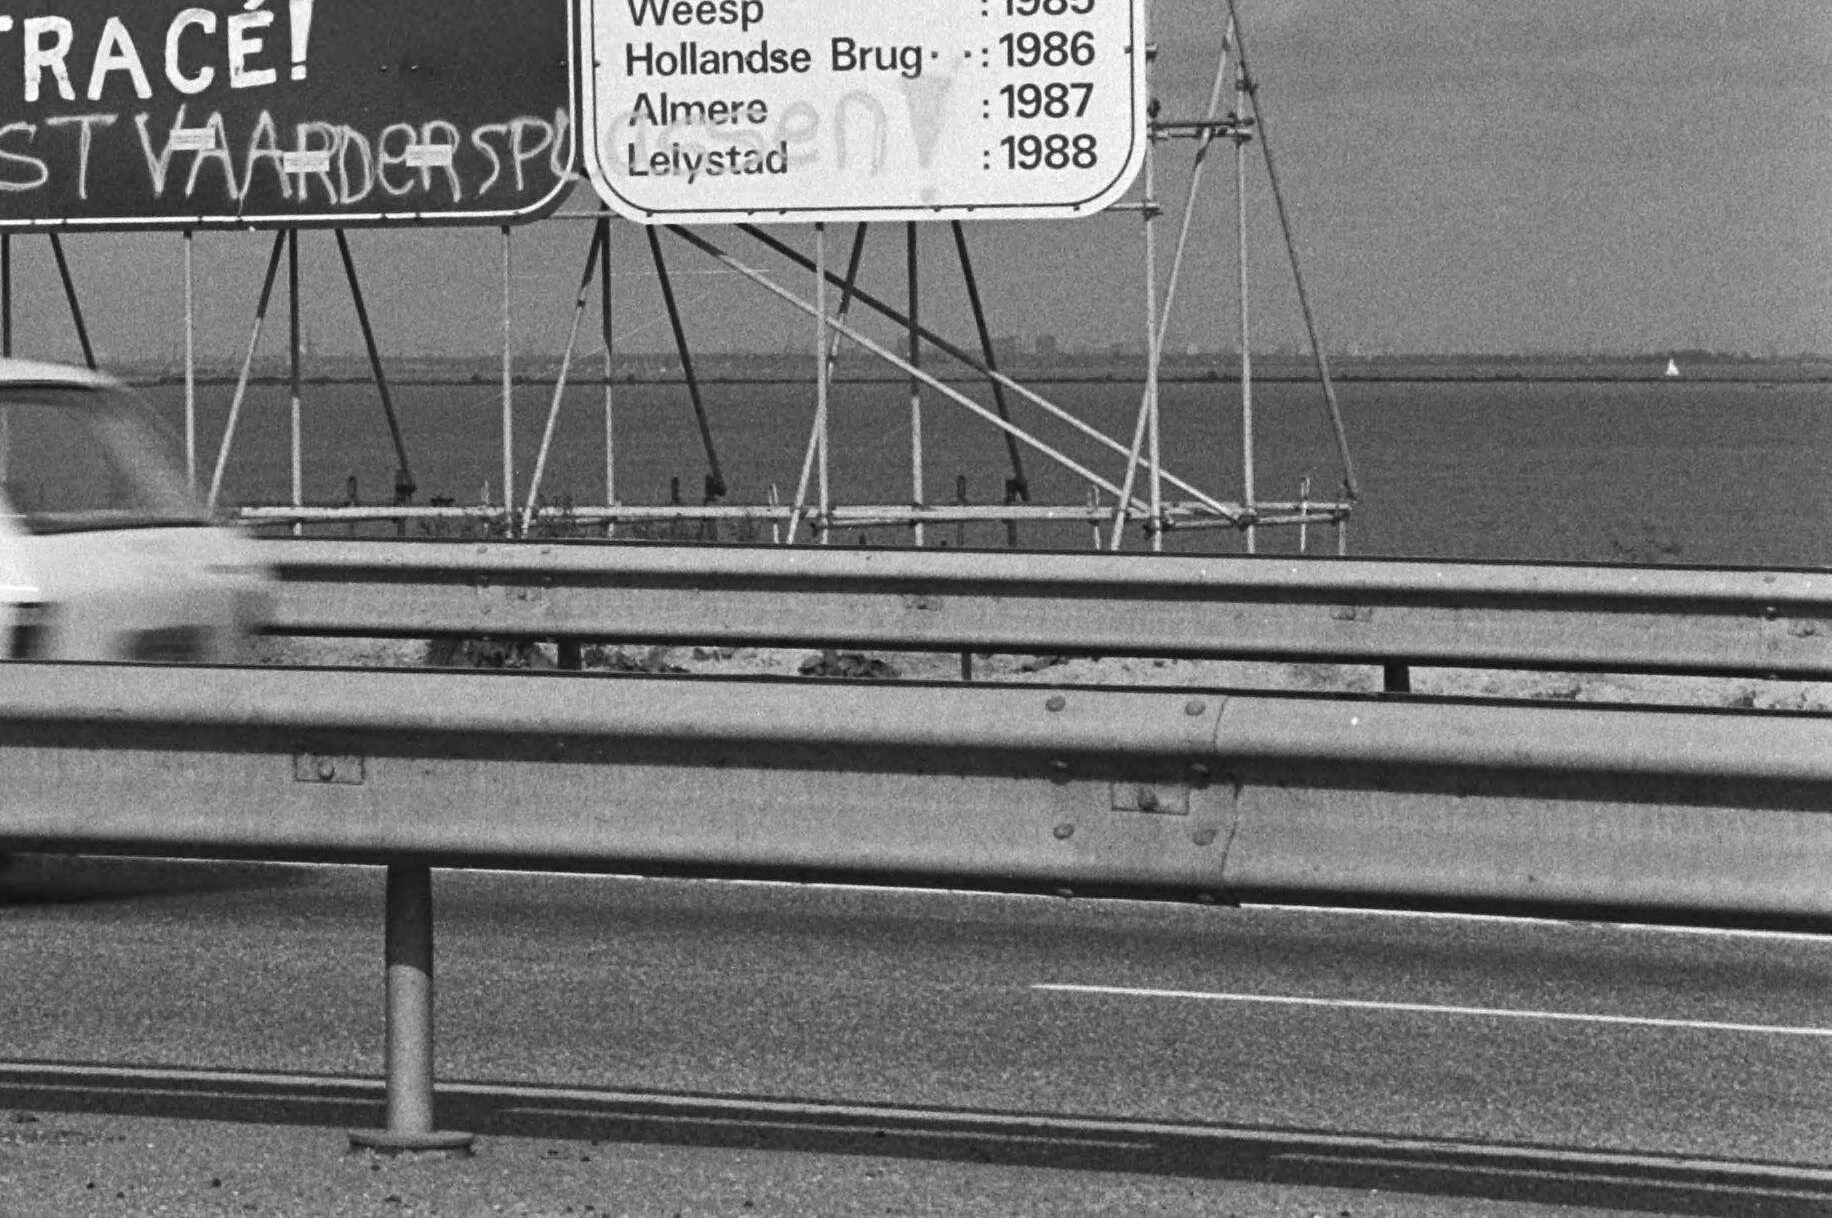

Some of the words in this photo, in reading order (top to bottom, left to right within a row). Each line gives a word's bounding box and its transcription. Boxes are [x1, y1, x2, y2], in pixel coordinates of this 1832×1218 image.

[626, 40, 812, 77] Hollandse
[831, 37, 922, 79] Brug
[629, 92, 768, 127] Almere
[628, 140, 788, 185] Lelystad
